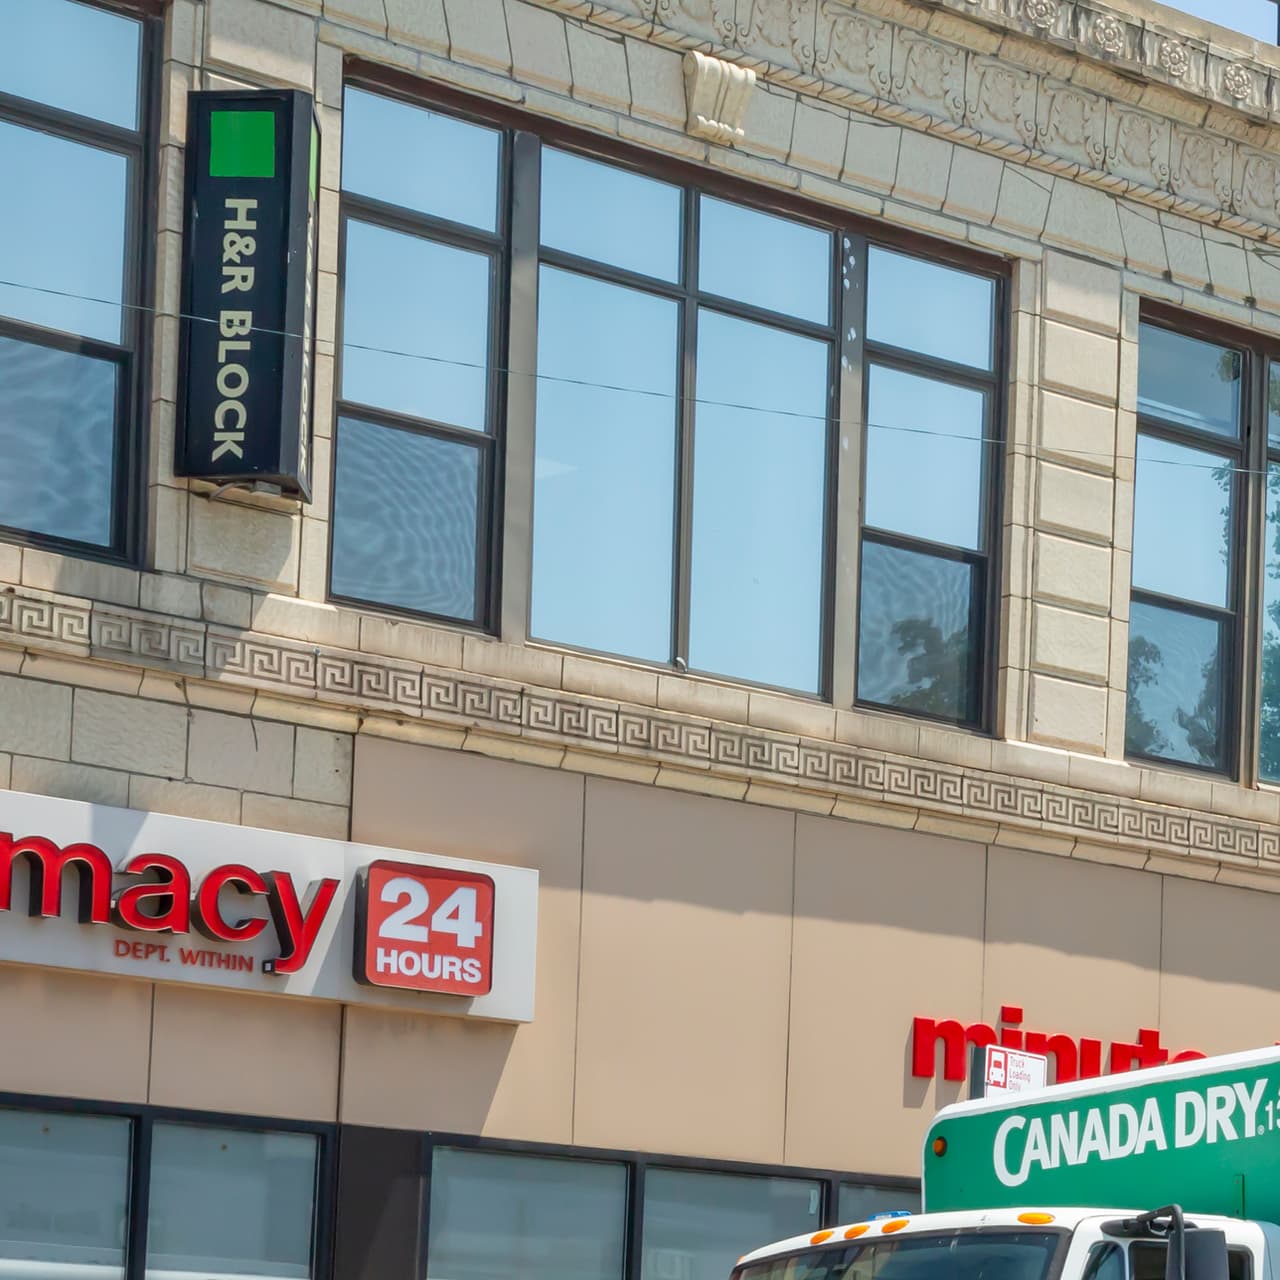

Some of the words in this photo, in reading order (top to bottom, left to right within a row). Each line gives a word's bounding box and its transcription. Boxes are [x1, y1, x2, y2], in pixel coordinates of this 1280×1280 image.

[220, 198, 258, 294] H&R
[211, 310, 253, 463] BLOCK
[378, 876, 483, 949] 24
[113, 938, 171, 963] DEPT.
[180, 948, 254, 973] WITHIN
[376, 949, 482, 984] HOURS
[993, 1097, 1168, 1187] CANADA
